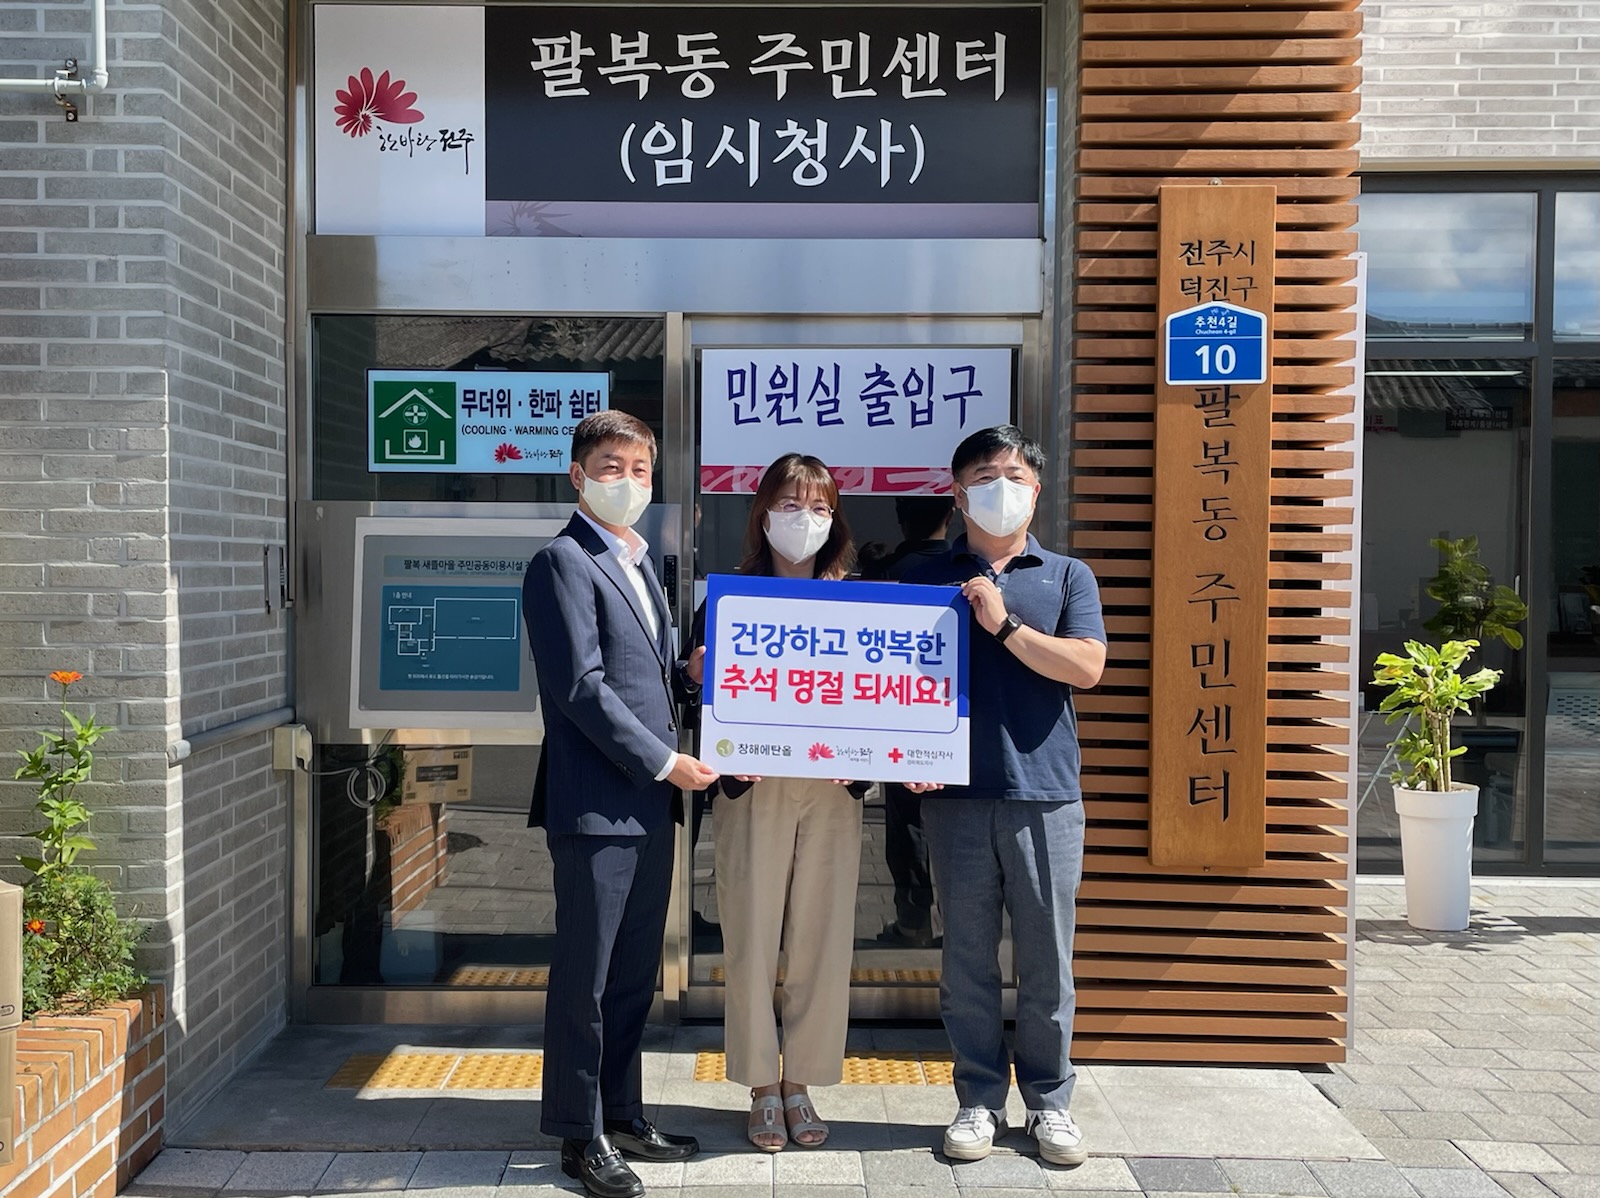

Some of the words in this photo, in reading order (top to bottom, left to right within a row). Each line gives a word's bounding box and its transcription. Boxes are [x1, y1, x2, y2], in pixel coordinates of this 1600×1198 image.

[529, 31, 730, 100] 팔복동
[749, 31, 1009, 101] 주민센터
[619, 117, 926, 189] (임시청사)
[1178, 238, 1257, 267] 전주시
[1180, 275, 1259, 303] 덕진구
[1194, 315, 1238, 329] 추천4길
[1195, 344, 1237, 375] 10
[461, 388, 511, 419] 무더위
[528, 388, 562, 419] 한파
[569, 388, 601, 419] 쉼터
[726, 360, 845, 429] 민원실
[858, 361, 985, 429] 출입구
[461, 424, 507, 436] (COOLING
[515, 426, 559, 436] WARMING
[561, 426, 577, 436] CE
[1191, 384, 1241, 542] 팔복동
[457, 560, 523, 571] 주민공동이용시설
[731, 622, 849, 659] 건강하고
[857, 627, 946, 665] 행복한
[720, 663, 778, 702] 추석
[787, 669, 844, 705] 명절
[853, 673, 951, 707] 되세요!
[1185, 572, 1242, 823] 주민센터
[737, 743, 792, 757] 창해에탄올
[907, 749, 954, 760] 대한적십자사
